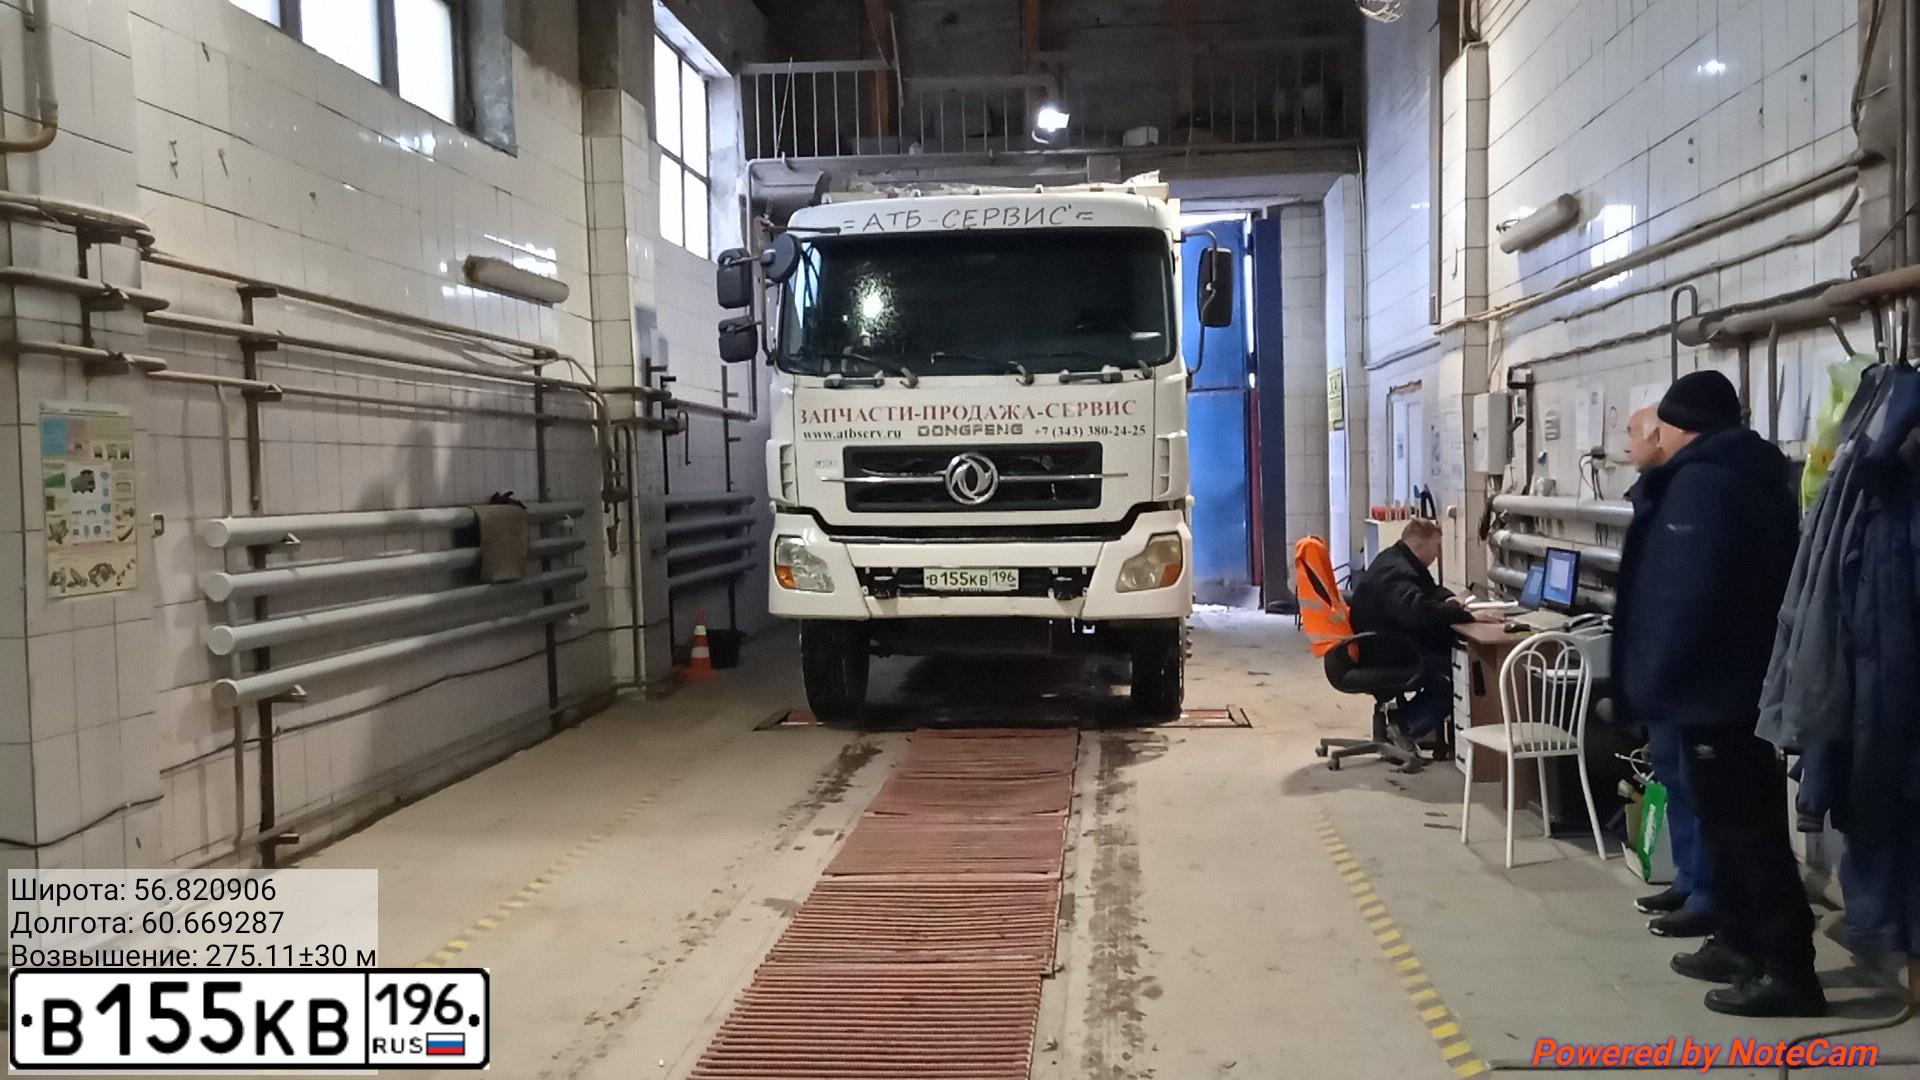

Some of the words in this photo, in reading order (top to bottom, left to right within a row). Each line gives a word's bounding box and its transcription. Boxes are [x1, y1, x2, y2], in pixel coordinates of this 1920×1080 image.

[800, 400, 1137, 424] ЗАПЧАСТИ-ПРОДАЖА-СЕРВИС
[917, 423, 1023, 437] DONGFENG
[1034, 426, 1049, 435] +7
[1052, 426, 1083, 438] (343)
[1087, 424, 1146, 436] 380-24-25
[992, 571, 1014, 582] 196
